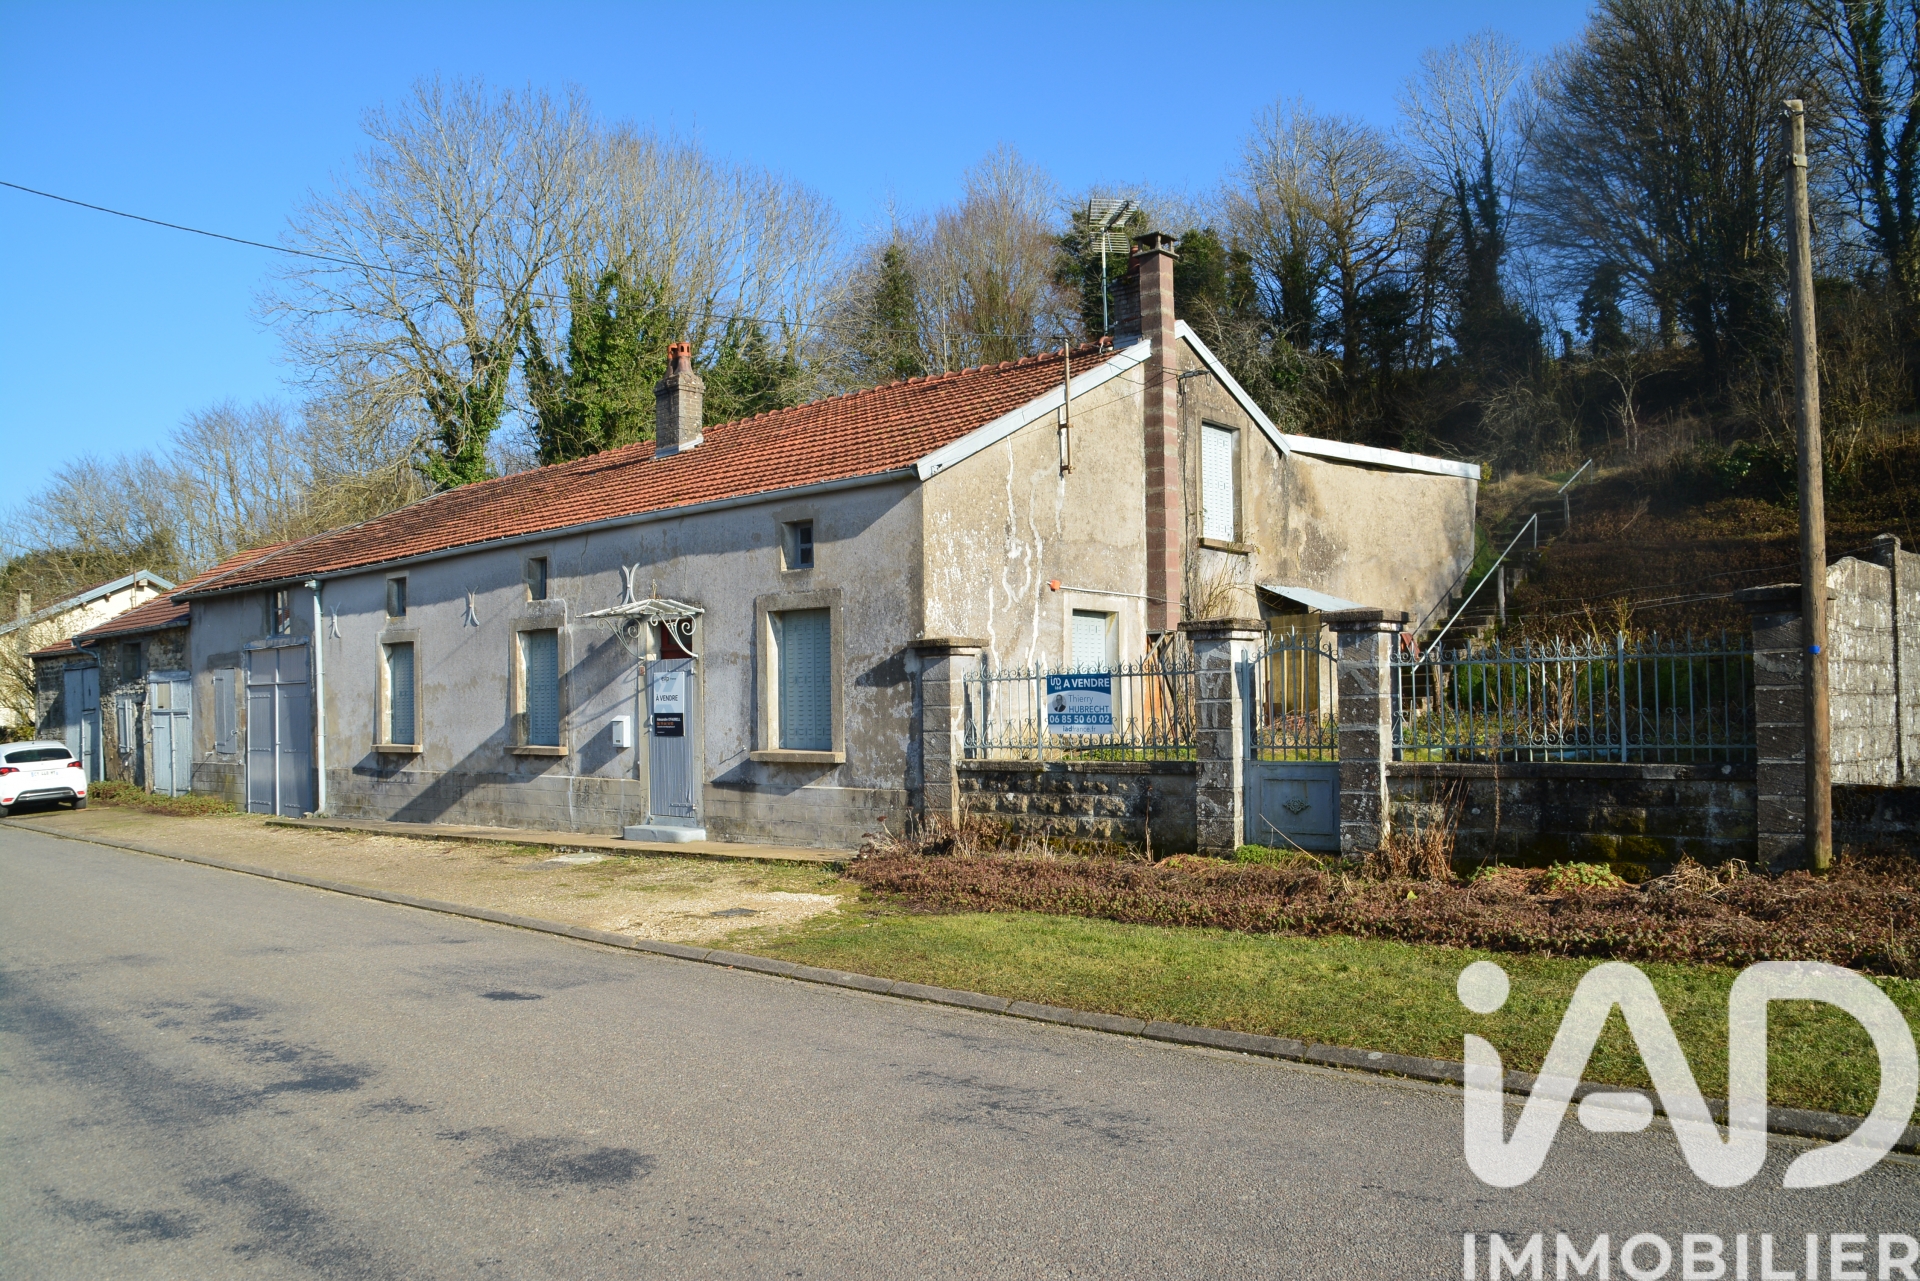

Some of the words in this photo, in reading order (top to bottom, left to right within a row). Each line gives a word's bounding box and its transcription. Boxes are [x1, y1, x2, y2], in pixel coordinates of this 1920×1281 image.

[1063, 679, 1070, 688] A
[1071, 678, 1110, 688] VENDRE
[1068, 695, 1094, 704] Thierry
[1049, 715, 1060, 723] 06
[1061, 715, 1072, 723] 85
[1073, 715, 1084, 723] 50
[1086, 715, 1097, 723] 60
[1098, 715, 1110, 723] 02
